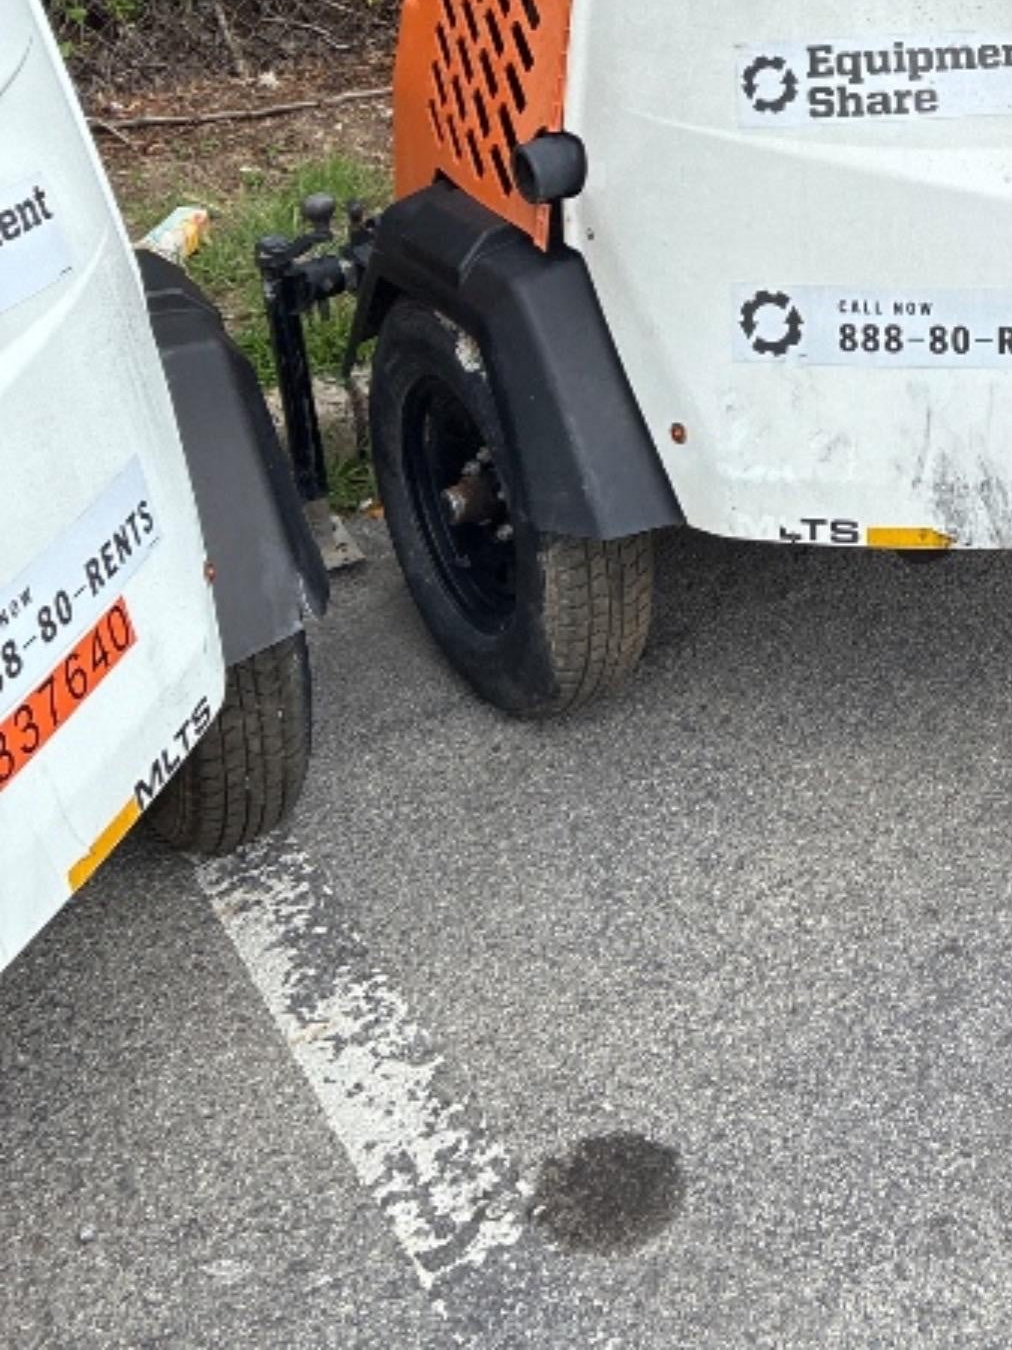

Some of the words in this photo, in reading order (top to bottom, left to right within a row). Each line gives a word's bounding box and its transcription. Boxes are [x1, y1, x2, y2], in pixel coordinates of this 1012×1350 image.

[807, 86, 938, 118] Share
[0, 184, 54, 247] ent
[838, 299, 884, 316] CALL
[893, 301, 934, 317] NOW
[779, 518, 860, 543] LTS
[0, 500, 154, 692] 8-80-RENTS
[133, 696, 212, 810] MLTS
